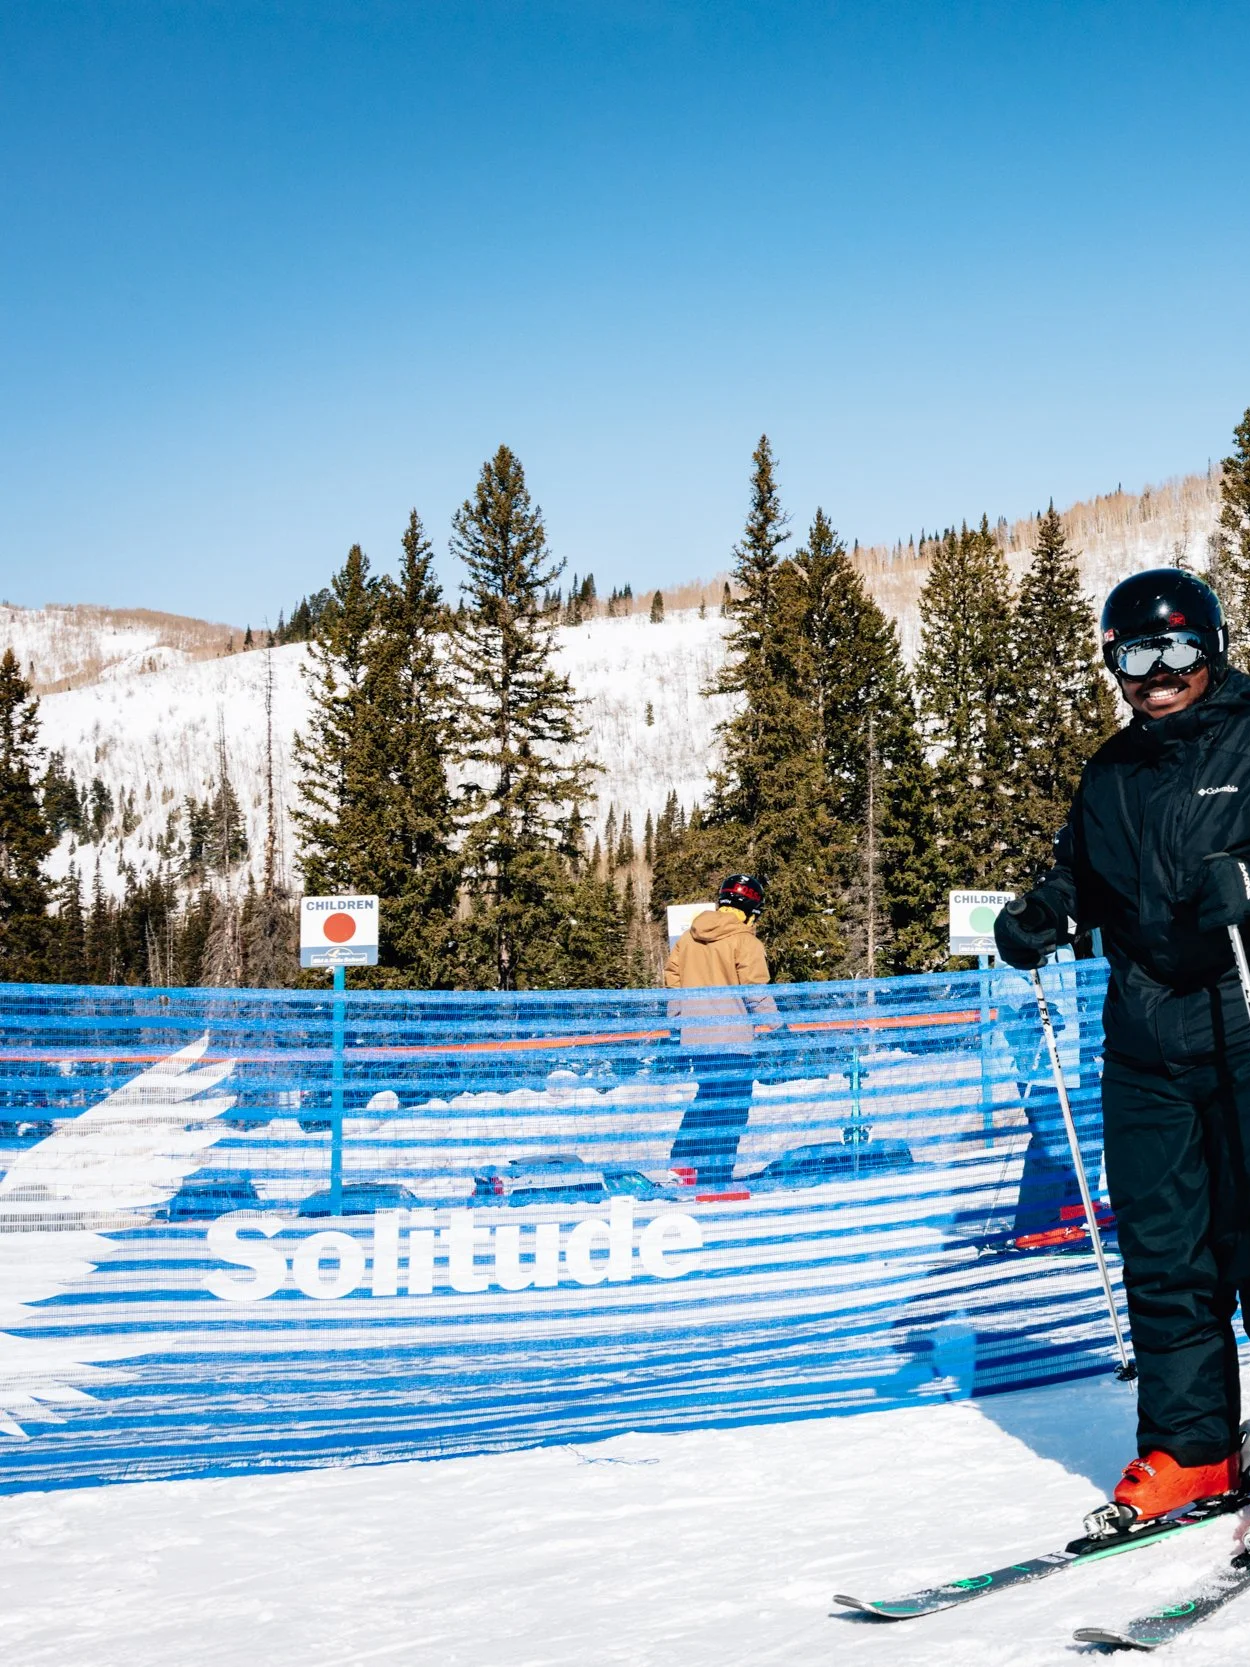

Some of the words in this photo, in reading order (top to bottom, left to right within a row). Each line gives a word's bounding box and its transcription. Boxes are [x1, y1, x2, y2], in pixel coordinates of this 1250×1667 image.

[1206, 784, 1239, 795] Columbia
[306, 899, 374, 911] CHILDREN
[204, 1196, 703, 1301] Solitude
